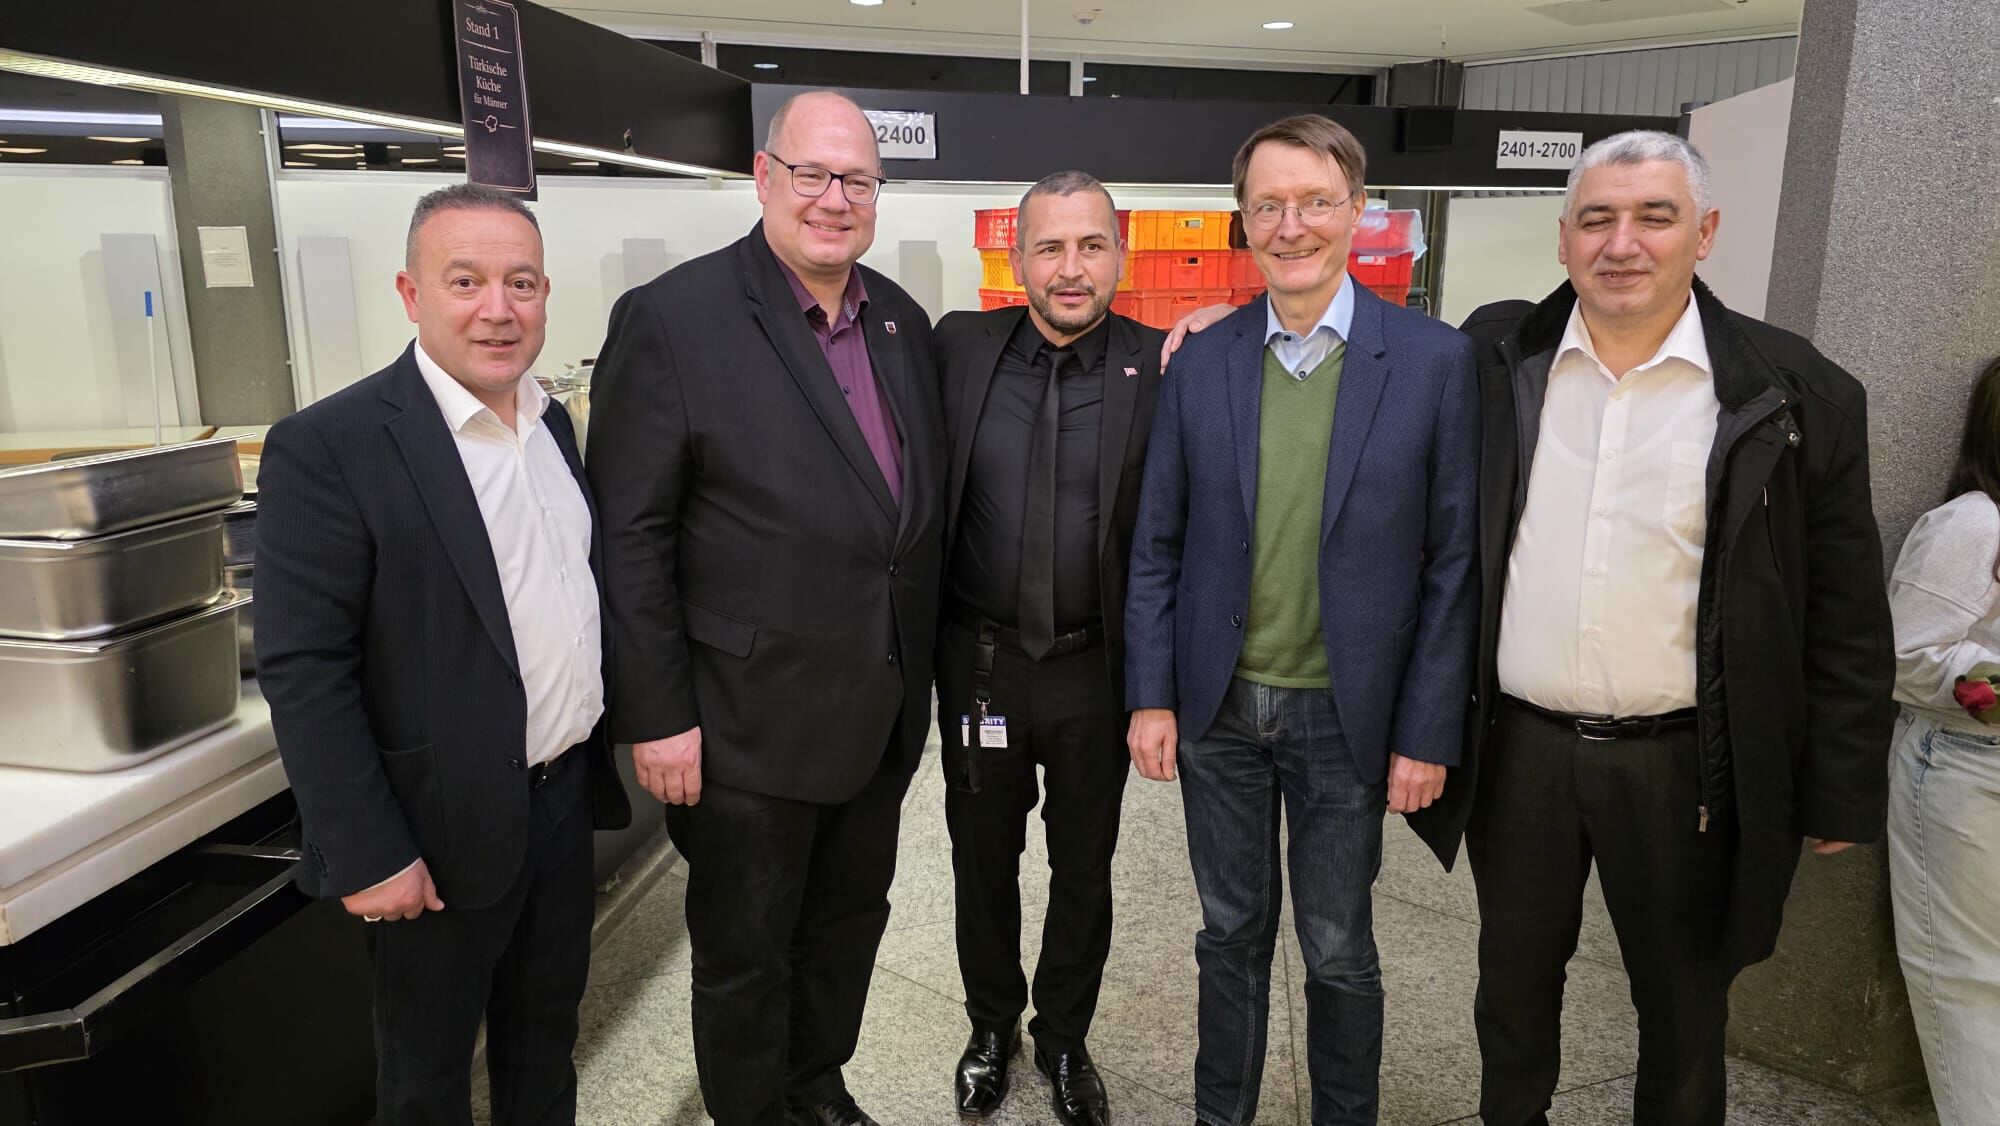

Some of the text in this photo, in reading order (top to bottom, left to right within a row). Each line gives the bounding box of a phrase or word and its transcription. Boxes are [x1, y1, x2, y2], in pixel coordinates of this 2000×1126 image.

[465, 17, 500, 39] Stand 1
[468, 55, 507, 76] Türkische
[476, 76, 502, 92] Küche
[474, 93, 508, 109] für Männer
[877, 125, 925, 144] 2400
[1500, 141, 1576, 158] 2401-2700
[962, 717, 1005, 725] SRITY
